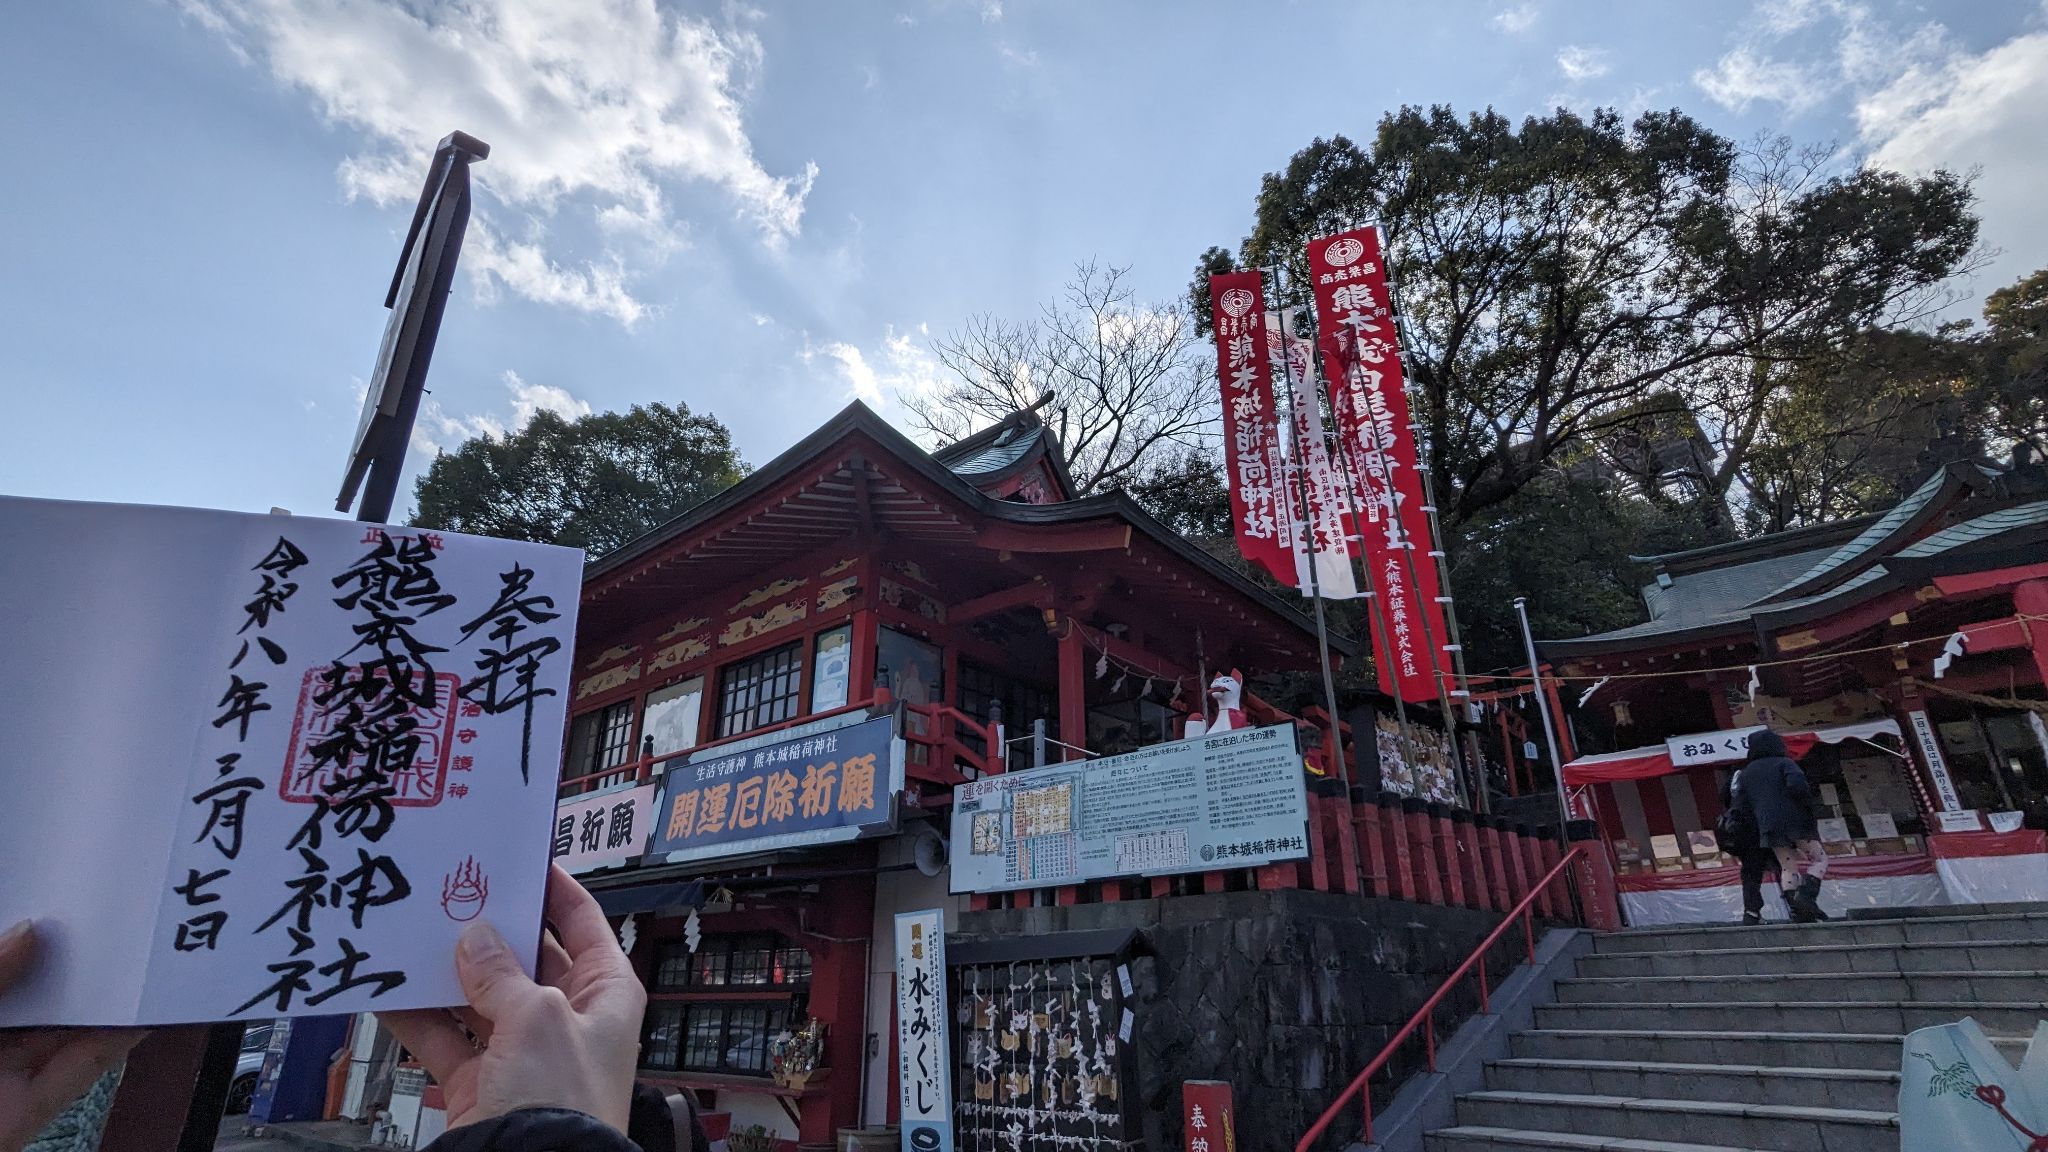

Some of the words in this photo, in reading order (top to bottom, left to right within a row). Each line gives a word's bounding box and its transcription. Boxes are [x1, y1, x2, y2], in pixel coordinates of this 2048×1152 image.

[753, 735, 838, 769] 熊本城稲荷神社
[666, 753, 877, 842] 開運厄除祈願
[1216, 836, 1304, 859] 熊本城稲荷神社
[908, 966, 935, 1115] 水みくじ
